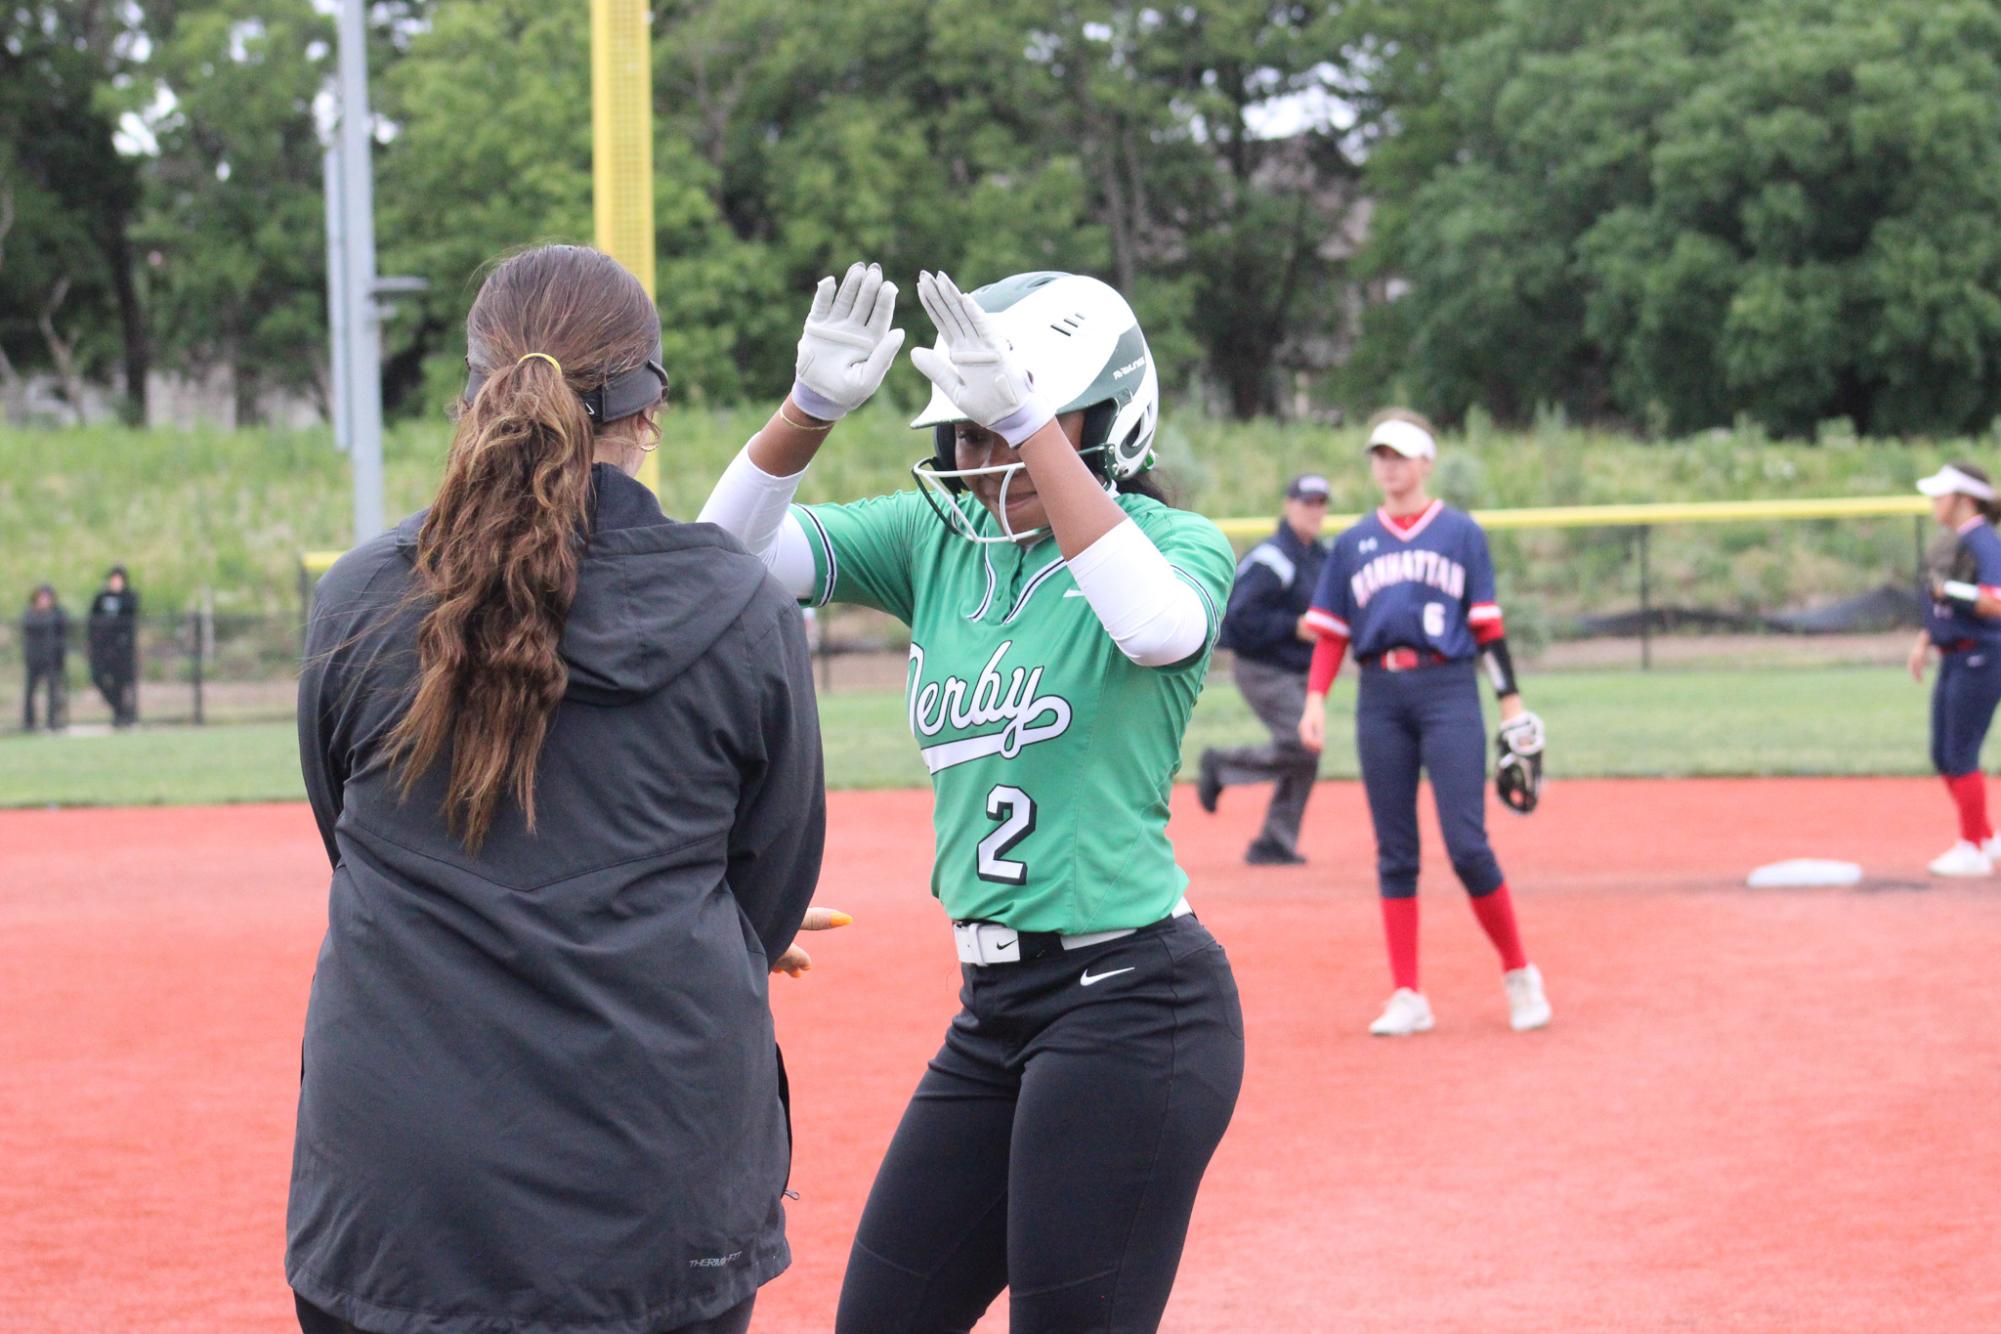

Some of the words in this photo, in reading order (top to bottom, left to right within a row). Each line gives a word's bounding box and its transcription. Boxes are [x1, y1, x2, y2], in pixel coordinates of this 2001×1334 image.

[1351, 550, 1466, 608] MANHATTAN
[1424, 602, 1446, 637] 6
[977, 784, 1037, 885] 2
